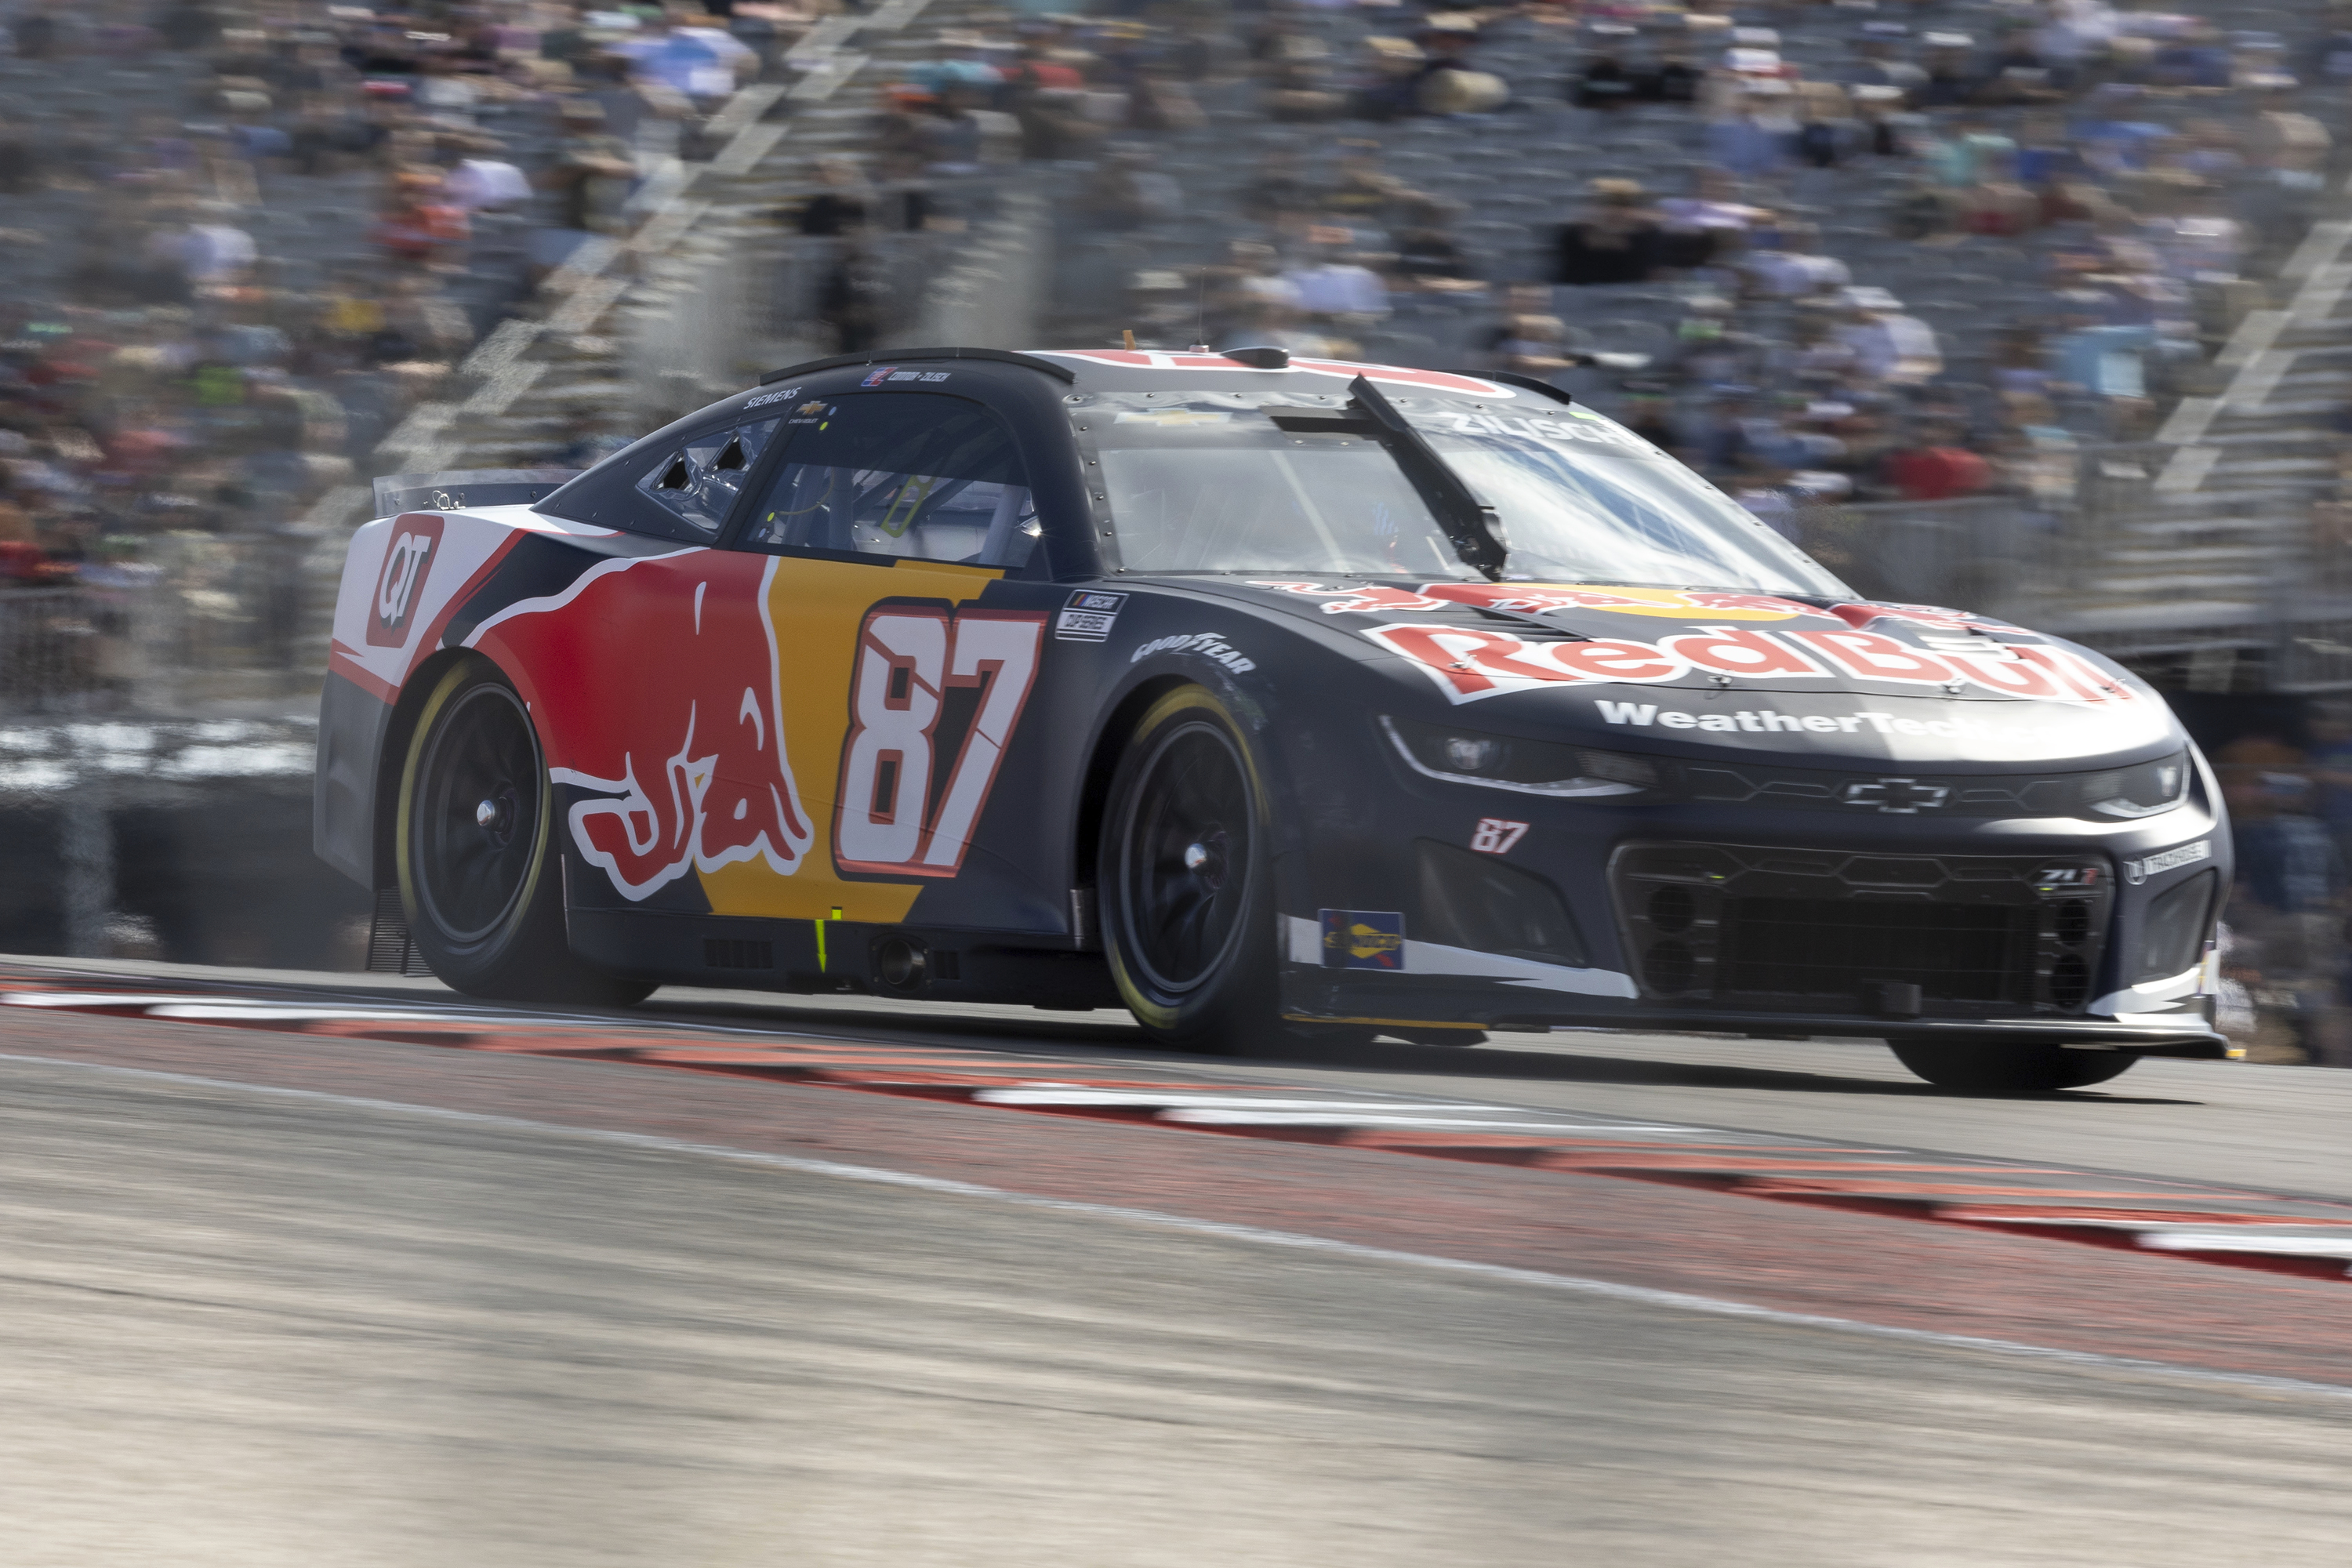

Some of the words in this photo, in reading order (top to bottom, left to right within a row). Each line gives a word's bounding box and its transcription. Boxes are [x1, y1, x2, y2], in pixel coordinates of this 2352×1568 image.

[743, 387, 801, 409] SIEMENS
[379, 532, 431, 626] QT
[1131, 632, 1256, 674] GOODYEAR
[1361, 623, 1835, 705] Red
[1780, 629, 2144, 706] Bull
[838, 608, 1049, 876] 87
[1471, 819, 1528, 853] 87
